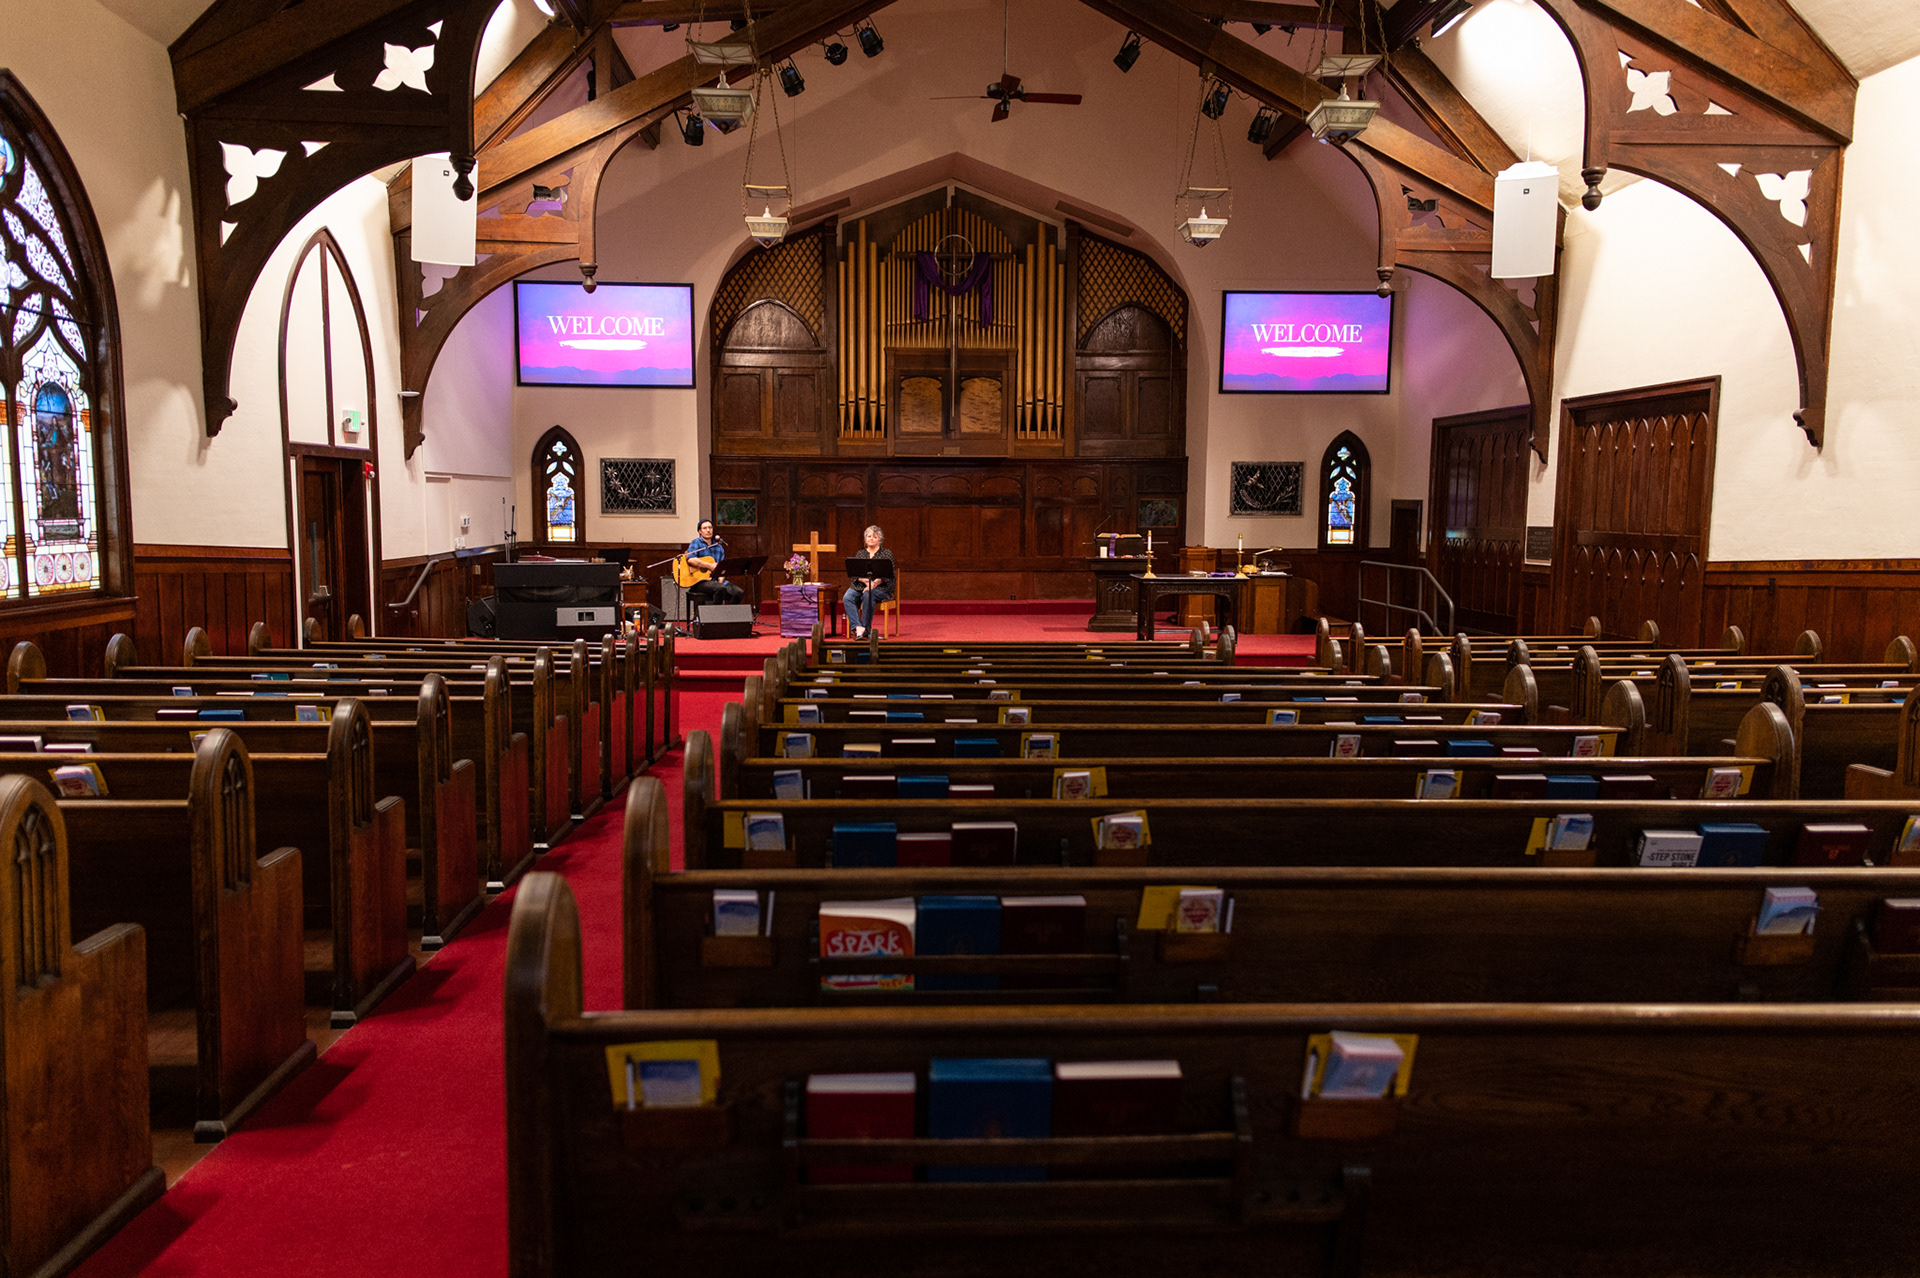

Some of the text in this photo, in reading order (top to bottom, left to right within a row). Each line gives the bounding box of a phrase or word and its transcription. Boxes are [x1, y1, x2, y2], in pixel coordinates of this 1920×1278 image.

[547, 315, 665, 337] WELCOME
[1251, 323, 1363, 343] WELCOME
[827, 929, 905, 957] SPARK
